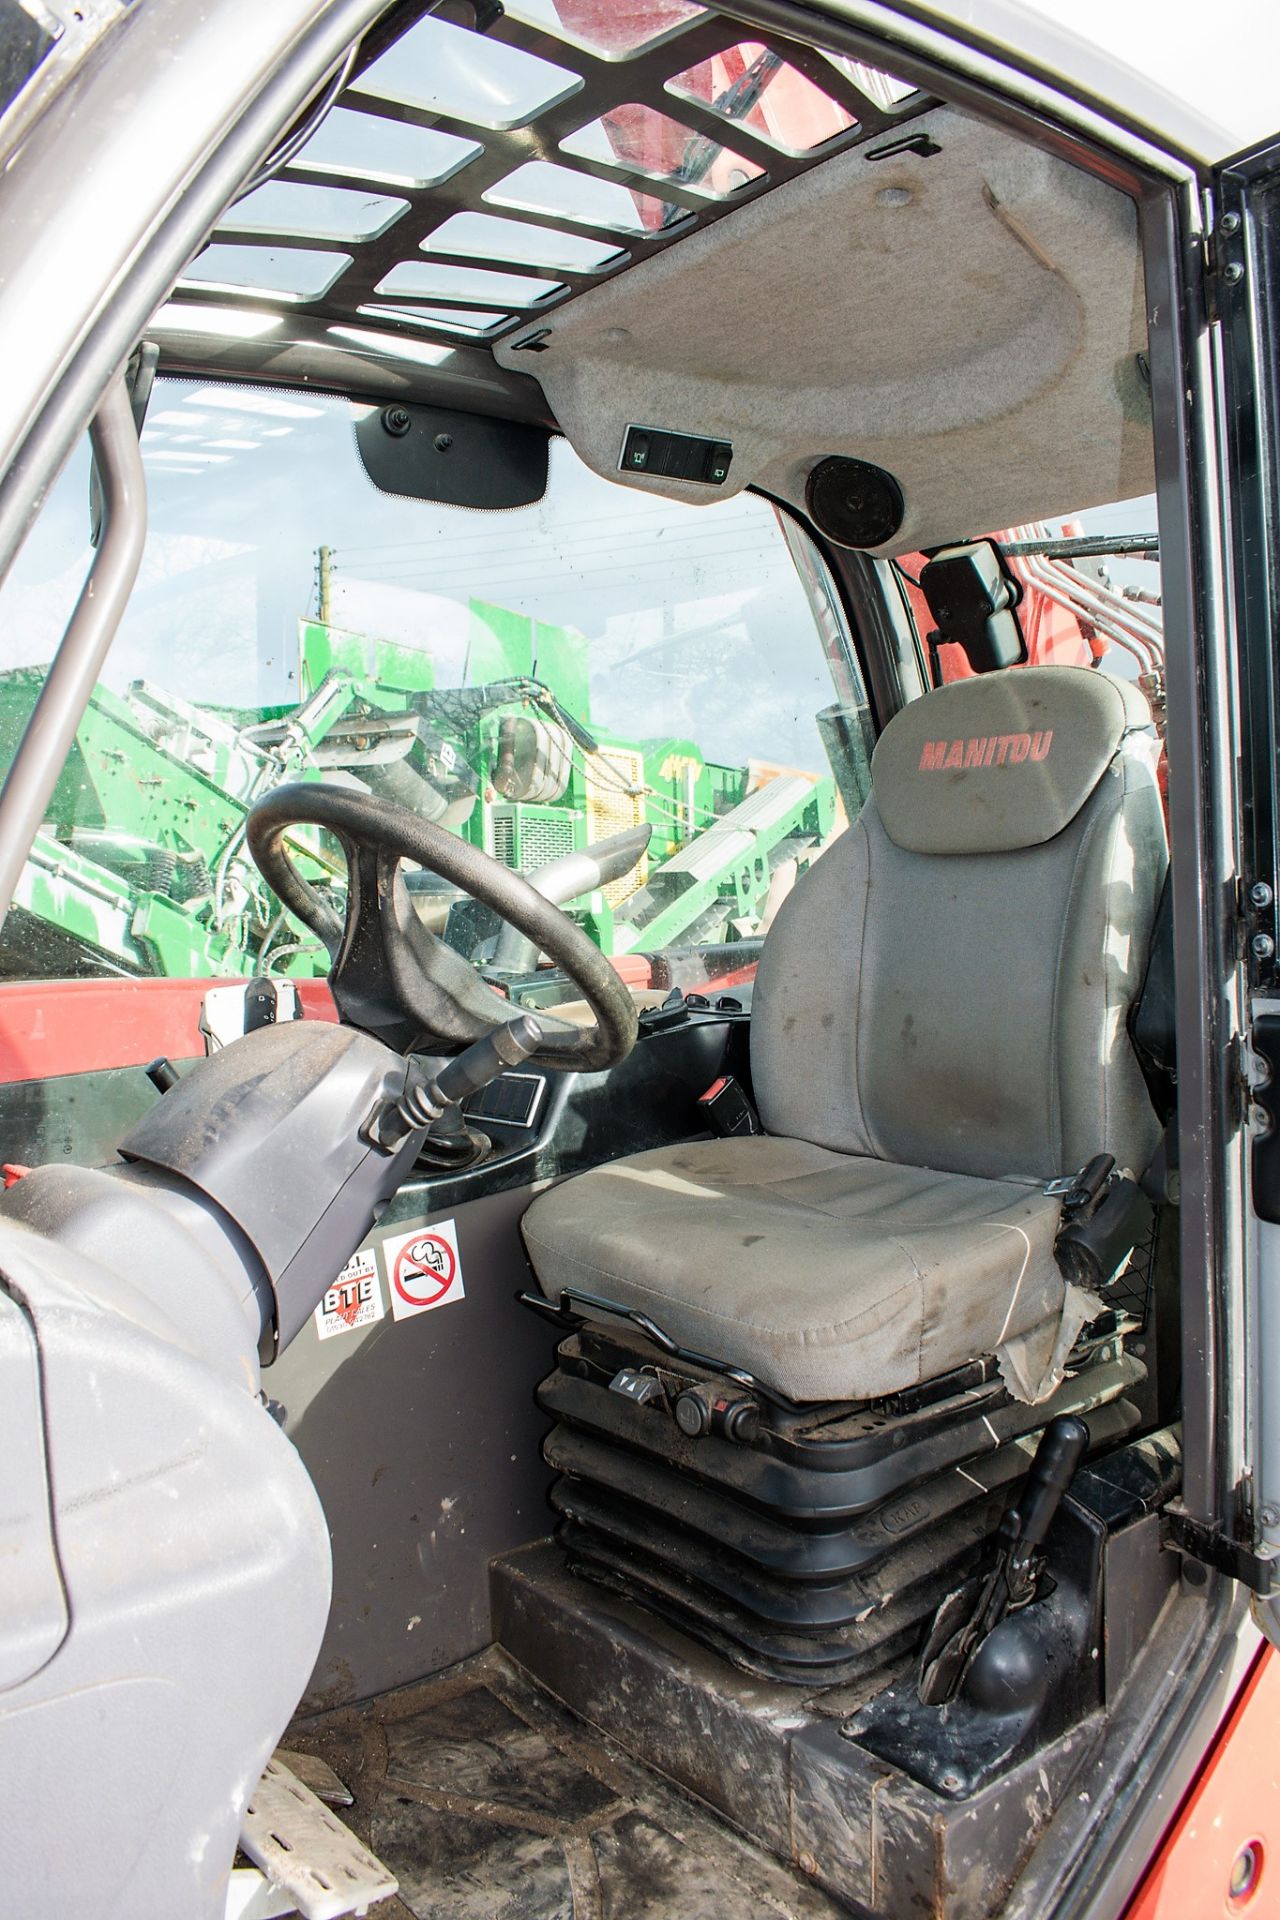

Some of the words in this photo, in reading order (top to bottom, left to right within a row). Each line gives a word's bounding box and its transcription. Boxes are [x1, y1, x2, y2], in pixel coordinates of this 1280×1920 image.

[918, 728, 1054, 771] MANITOU
[323, 1280, 374, 1315] BTE
[351, 1302, 376, 1316] SALES
